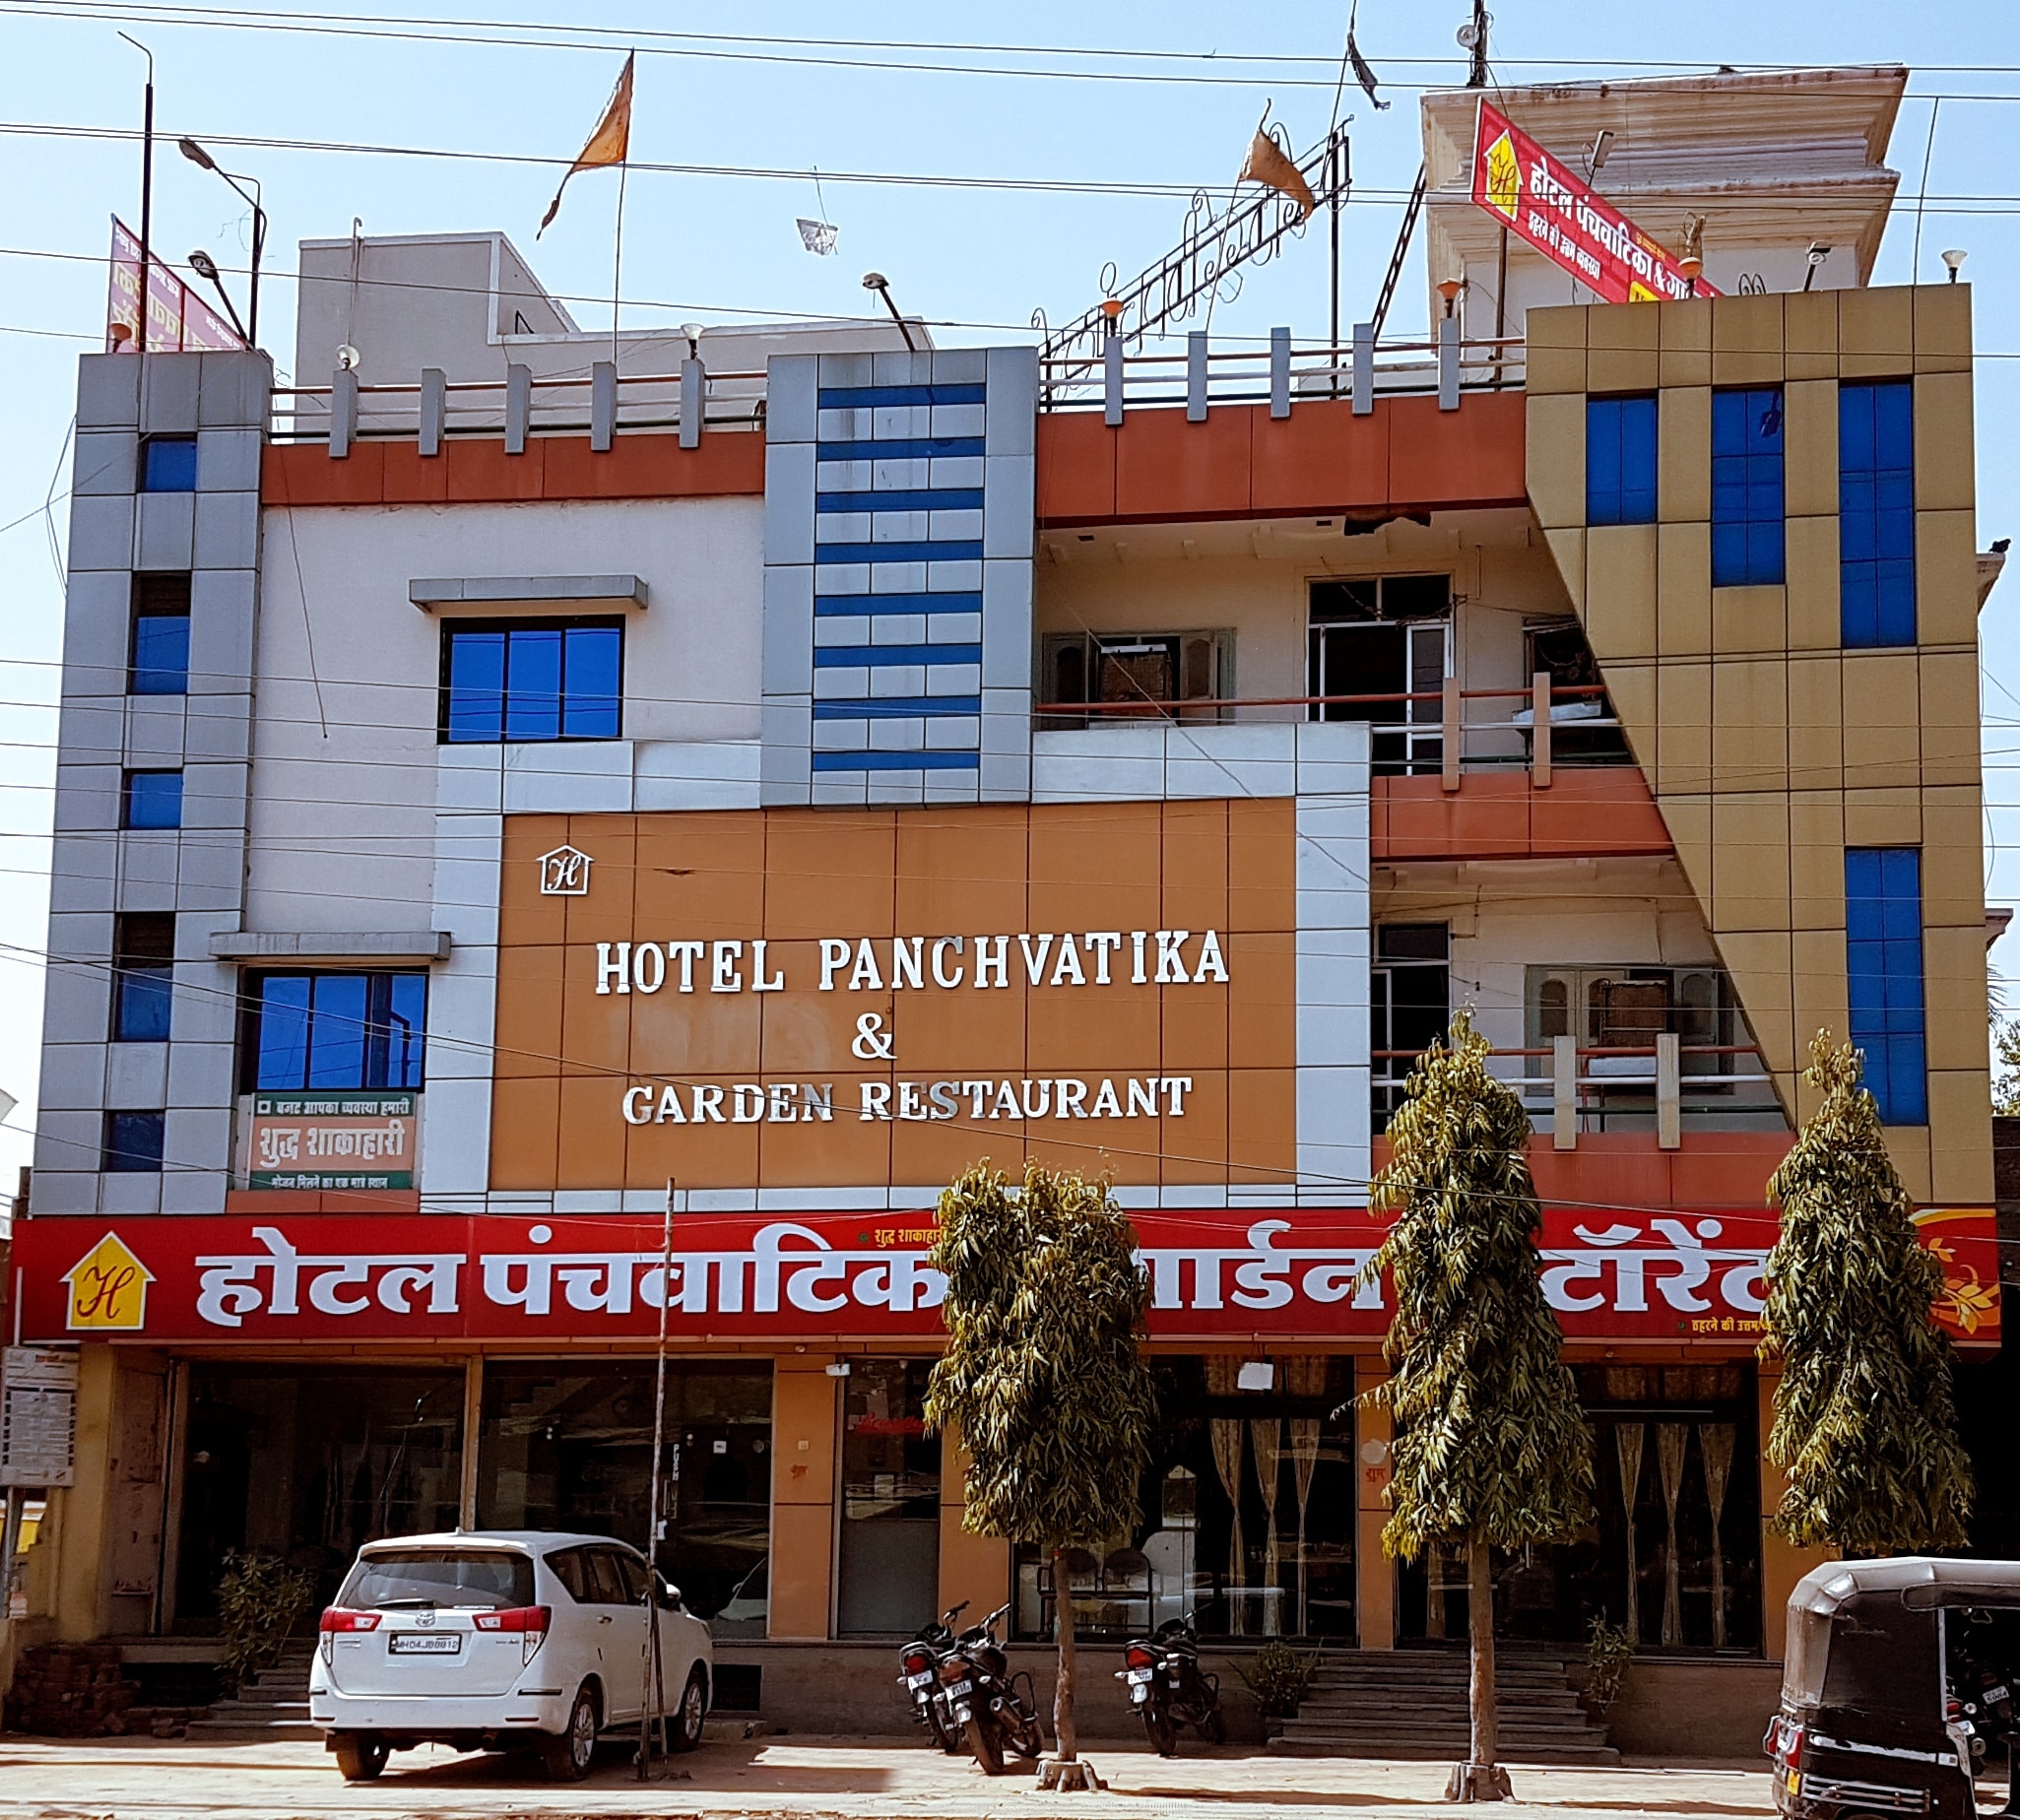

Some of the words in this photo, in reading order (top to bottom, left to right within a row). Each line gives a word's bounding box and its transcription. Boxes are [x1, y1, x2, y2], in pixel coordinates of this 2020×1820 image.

[1530, 155, 1574, 221] होटल
[1576, 194, 1654, 283] पंचवाटिका
[1654, 261, 1666, 292] &
[595, 940, 785, 995] HOTEL
[818, 930, 1230, 993] PANCHVATIKA
[850, 1012, 897, 1061] &
[622, 1080, 834, 1126] GARDEN
[859, 1075, 1194, 1123] RESTAURANT
[259, 1127, 301, 1168] शुद्ध
[306, 1119, 406, 1161] शाकाहारी
[874, 1228, 896, 1248] शुद्ध
[194, 1225, 467, 1329] होटल
[480, 1222, 949, 1316] पंचवाटिक
[1721, 1316, 1734, 1332] की
